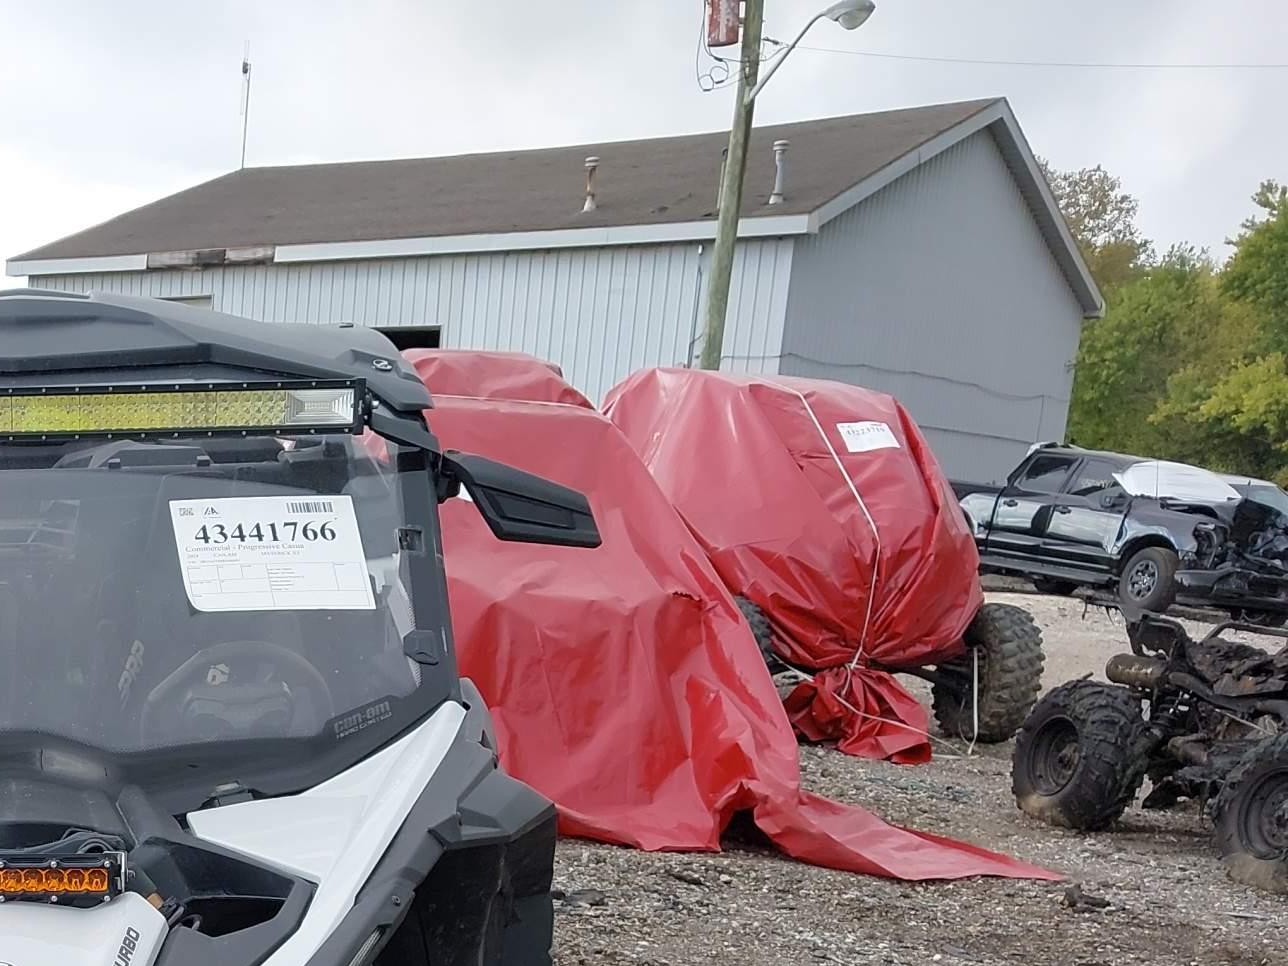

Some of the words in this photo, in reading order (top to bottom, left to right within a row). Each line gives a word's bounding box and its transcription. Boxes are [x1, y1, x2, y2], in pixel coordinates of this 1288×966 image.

[194, 520, 337, 544] 43441766
[185, 544, 231, 552] Commercial
[238, 543, 281, 552] Progressive
[334, 701, 391, 733] can-am
